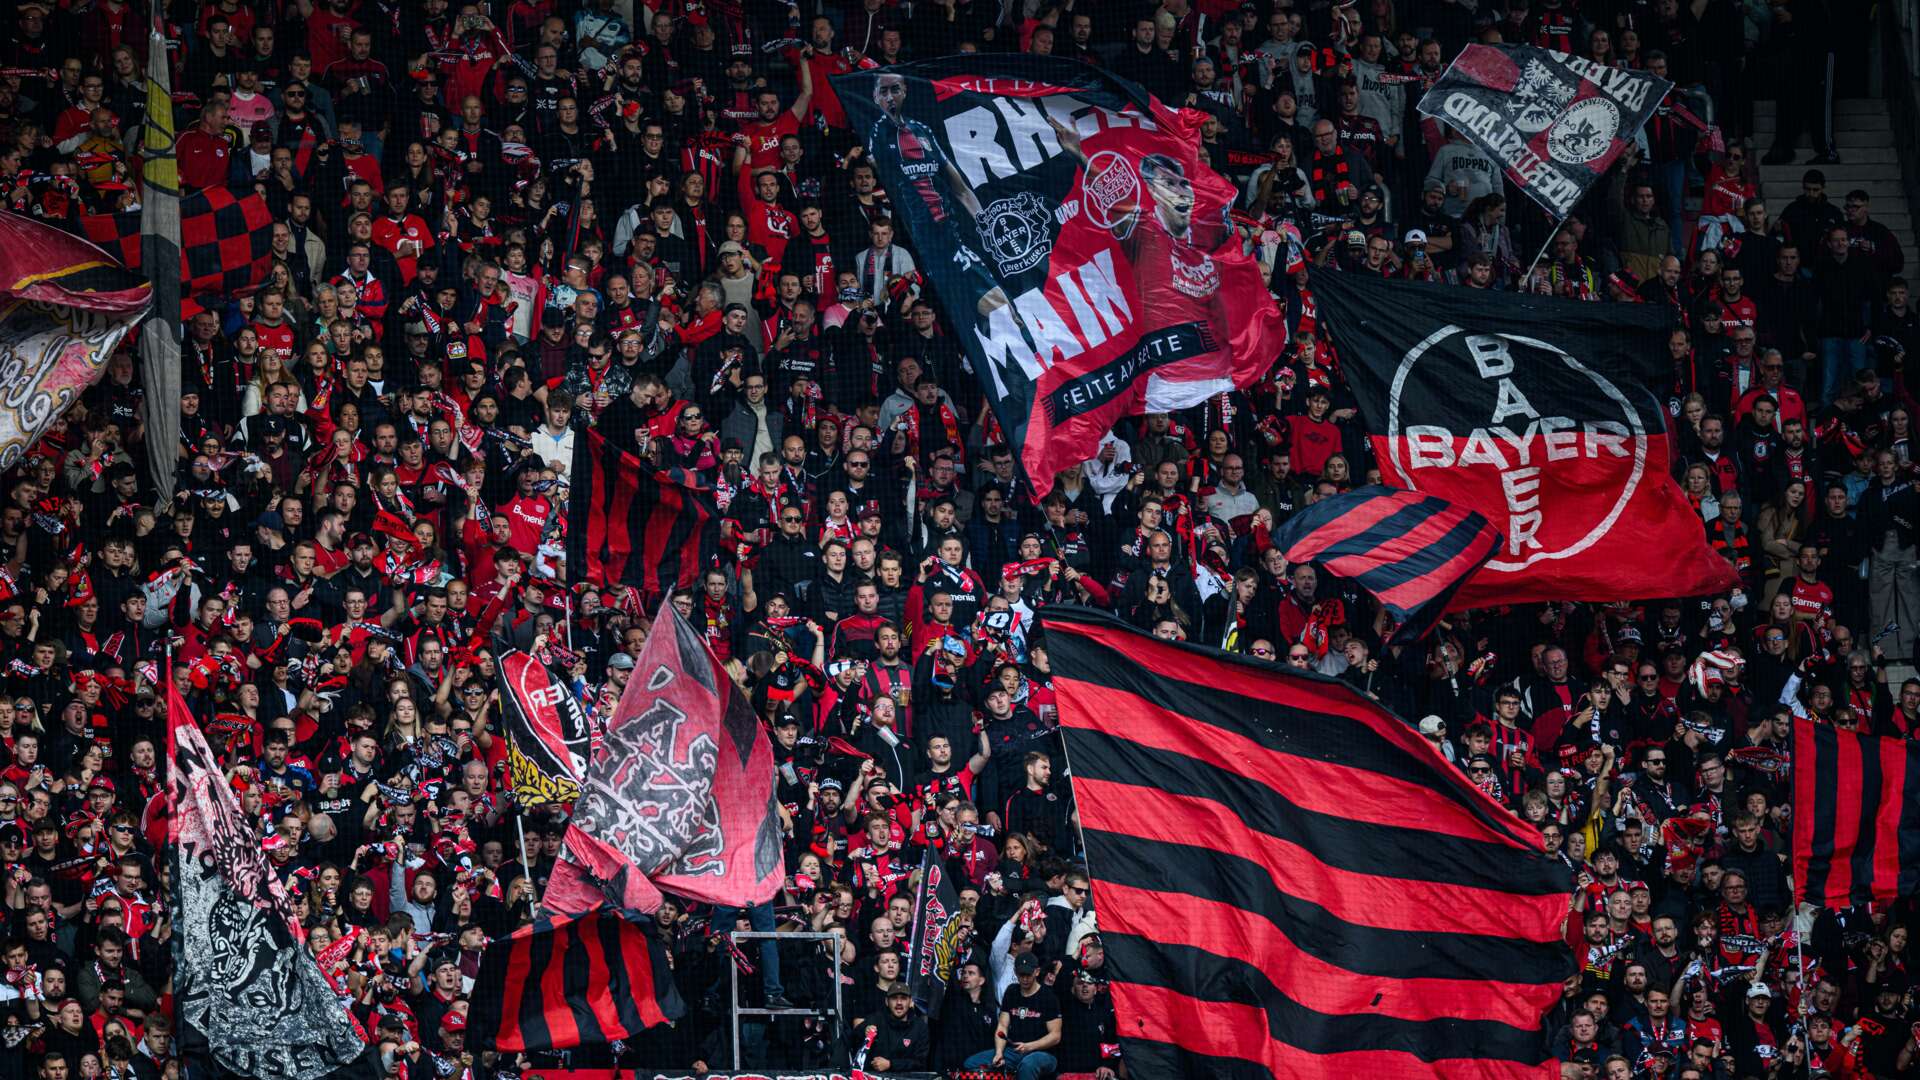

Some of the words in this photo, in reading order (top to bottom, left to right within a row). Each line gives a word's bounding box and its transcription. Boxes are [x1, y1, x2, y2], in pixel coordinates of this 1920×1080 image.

[974, 248, 1134, 401] MAIN
[1063, 372, 1117, 409] SEITE
[1405, 416, 1632, 470] BAYER
[1465, 334, 1544, 556] BAYER
